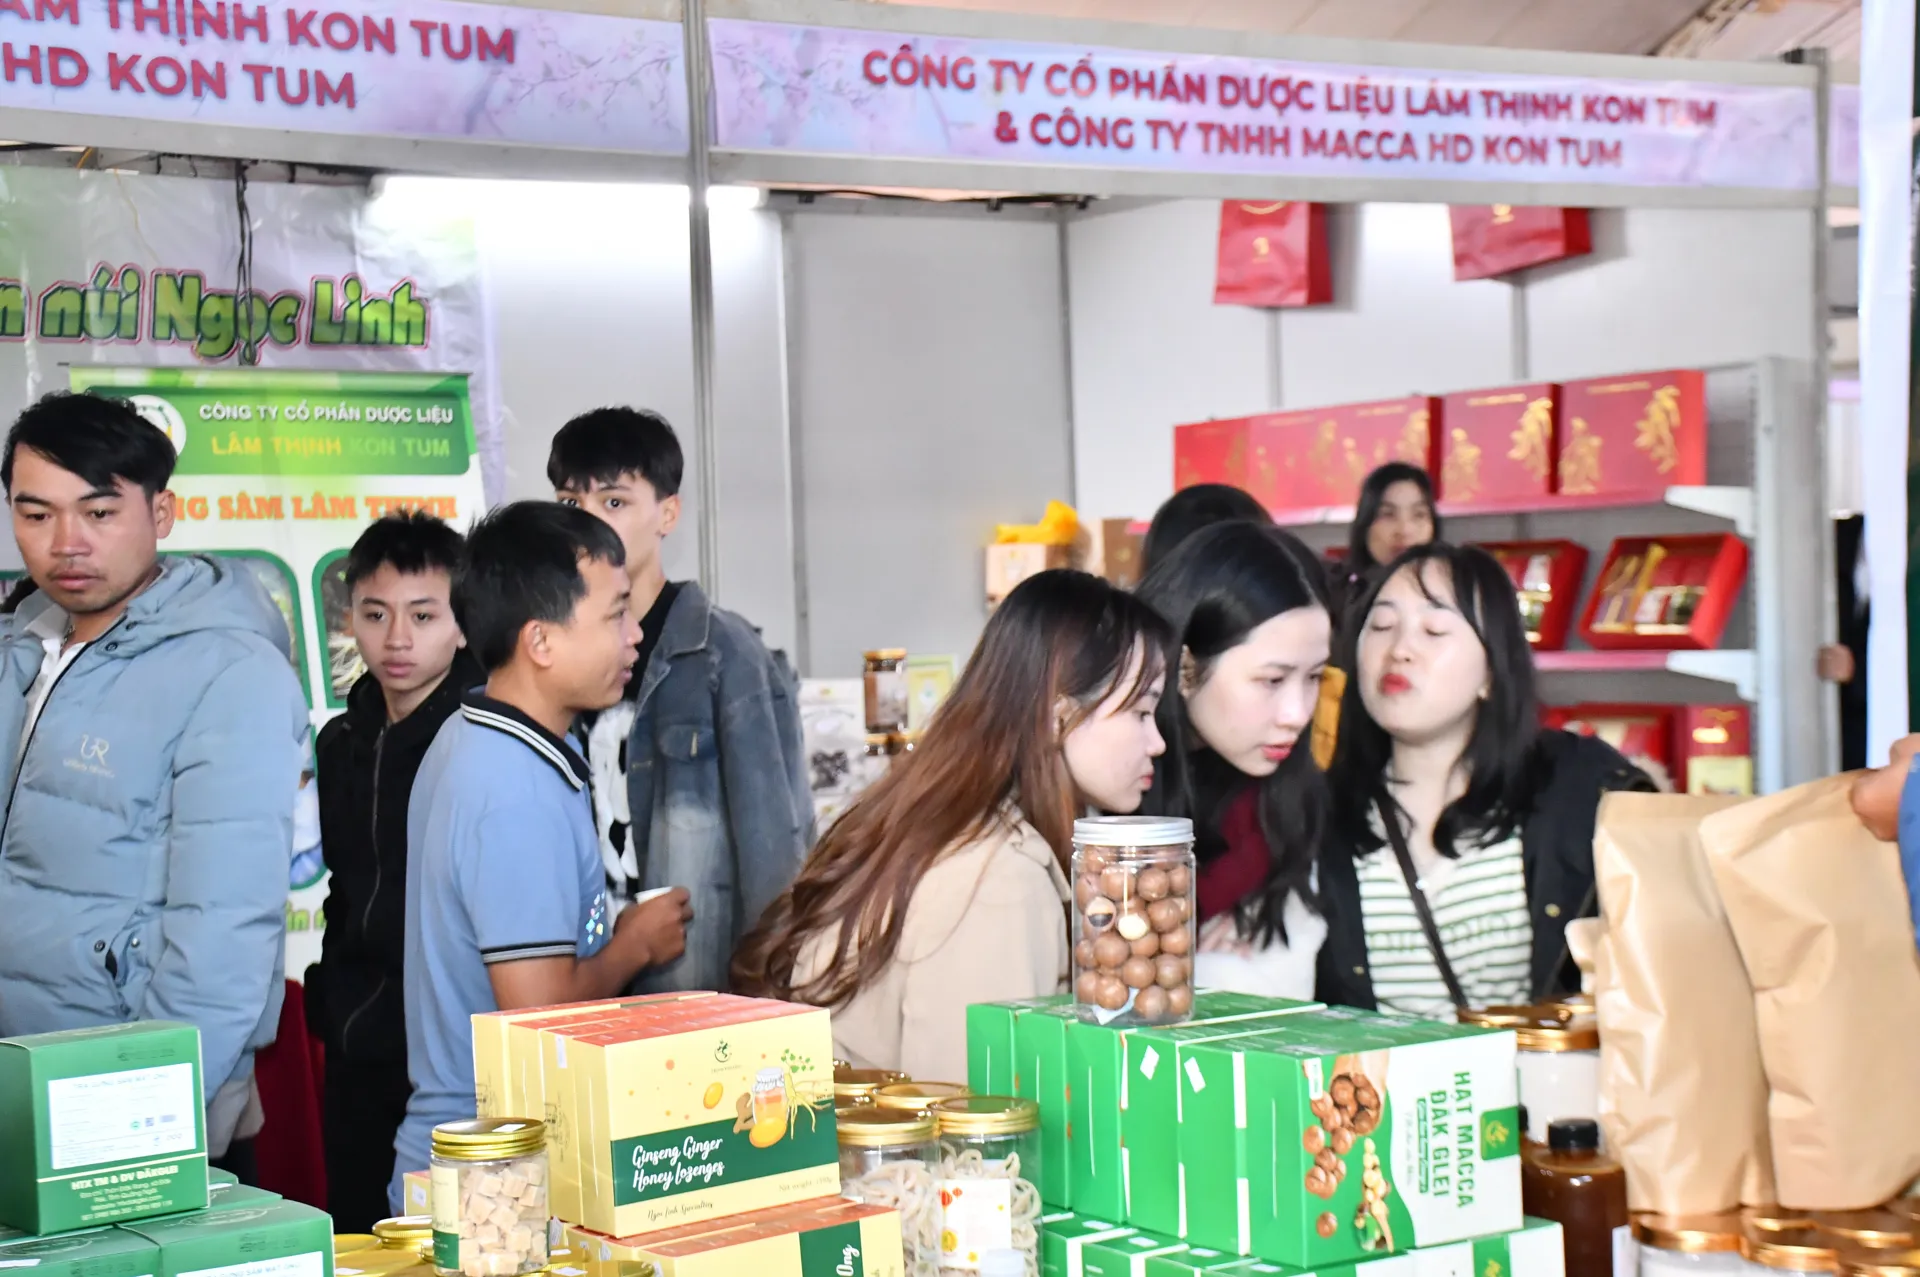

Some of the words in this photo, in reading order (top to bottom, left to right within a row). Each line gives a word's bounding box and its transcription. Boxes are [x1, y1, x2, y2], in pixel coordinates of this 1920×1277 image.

[287, 8, 396, 54] KON
[410, 20, 515, 64] TUM
[2, 42, 89, 88] HD
[108, 52, 227, 100] KON
[242, 64, 356, 109] TUM
[863, 44, 976, 90] CÔNG
[989, 59, 1034, 94] TY
[1218, 73, 1315, 117] DƯỢC
[1326, 76, 1394, 120] LIỆU
[1405, 79, 1471, 117] LÂM
[1583, 96, 1645, 125] KON
[1657, 98, 1718, 127] TUM
[995, 111, 1019, 143] &
[1030, 106, 1135, 149] CÔNG
[1146, 119, 1187, 151] TY
[1196, 122, 1291, 157] TNHH
[1301, 129, 1418, 161] MACCA
[1428, 133, 1474, 163] HD
[1484, 135, 1549, 165] KON
[1558, 138, 1622, 168] TUM
[39, 263, 145, 342] núi
[149, 268, 304, 366] Ngọc
[306, 273, 430, 350] Linh
[200, 401, 252, 421] CÔNG
[256, 404, 280, 421] TY
[417, 403, 454, 427] LIỆU
[211, 432, 262, 456] LÂM
[403, 437, 450, 457] TUM
[218, 491, 284, 520] SÂM
[291, 491, 358, 520] LÂM
[632, 1145, 681, 1168] Ginseng
[683, 1135, 723, 1159] Ginger
[1432, 1147, 1450, 1196] GLEI
[1457, 1125, 1474, 1208] MACCA
[71, 1179, 93, 1190] HTX
[632, 1168, 674, 1192] Honey
